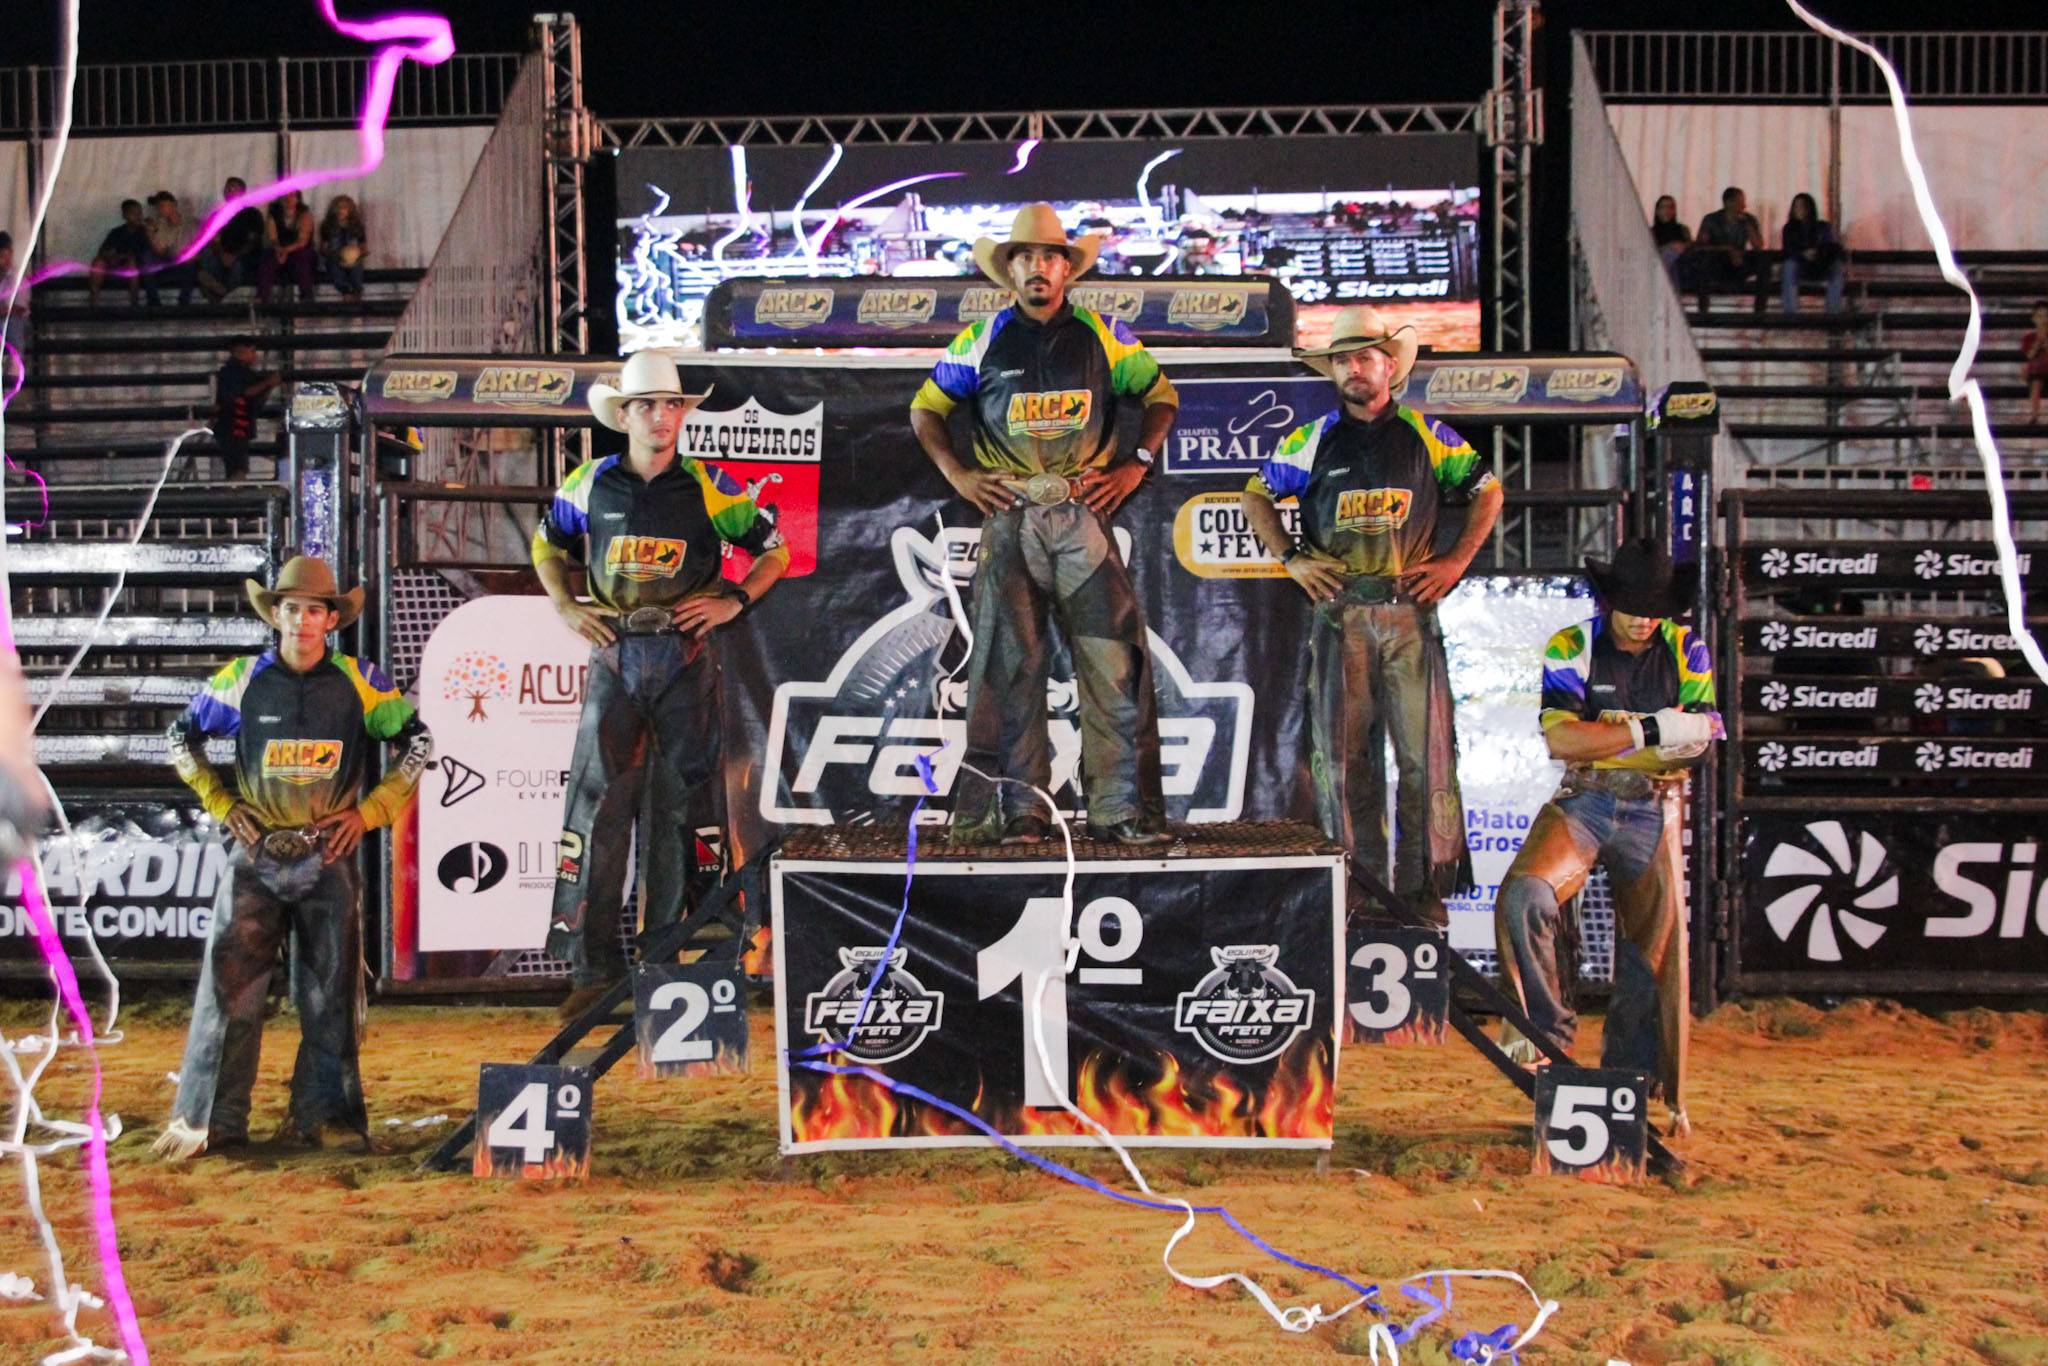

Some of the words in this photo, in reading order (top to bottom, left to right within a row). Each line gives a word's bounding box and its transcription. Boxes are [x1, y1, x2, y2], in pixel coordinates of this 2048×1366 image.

[1336, 279, 1450, 298] Sicredi
[744, 409, 759, 424] OS
[686, 424, 816, 458] VAQUEIROS
[1793, 552, 1878, 575] Sicredi
[1947, 553, 2031, 576] Sicrei
[1793, 626, 1878, 649] Sicredi
[1793, 686, 1878, 709] Sicredi
[1946, 687, 2032, 710] Sicredi
[1791, 745, 1879, 768] Sicredi
[1949, 747, 2033, 769] Sicredi
[1467, 808, 1530, 830] Mato
[93, 905, 213, 938] COMIG
[1349, 942, 1438, 1029] 3º
[976, 896, 1144, 1108] 1º
[649, 978, 737, 1063] 2º
[487, 1082, 582, 1163] 4º
[1546, 1084, 1636, 1166] 5º
